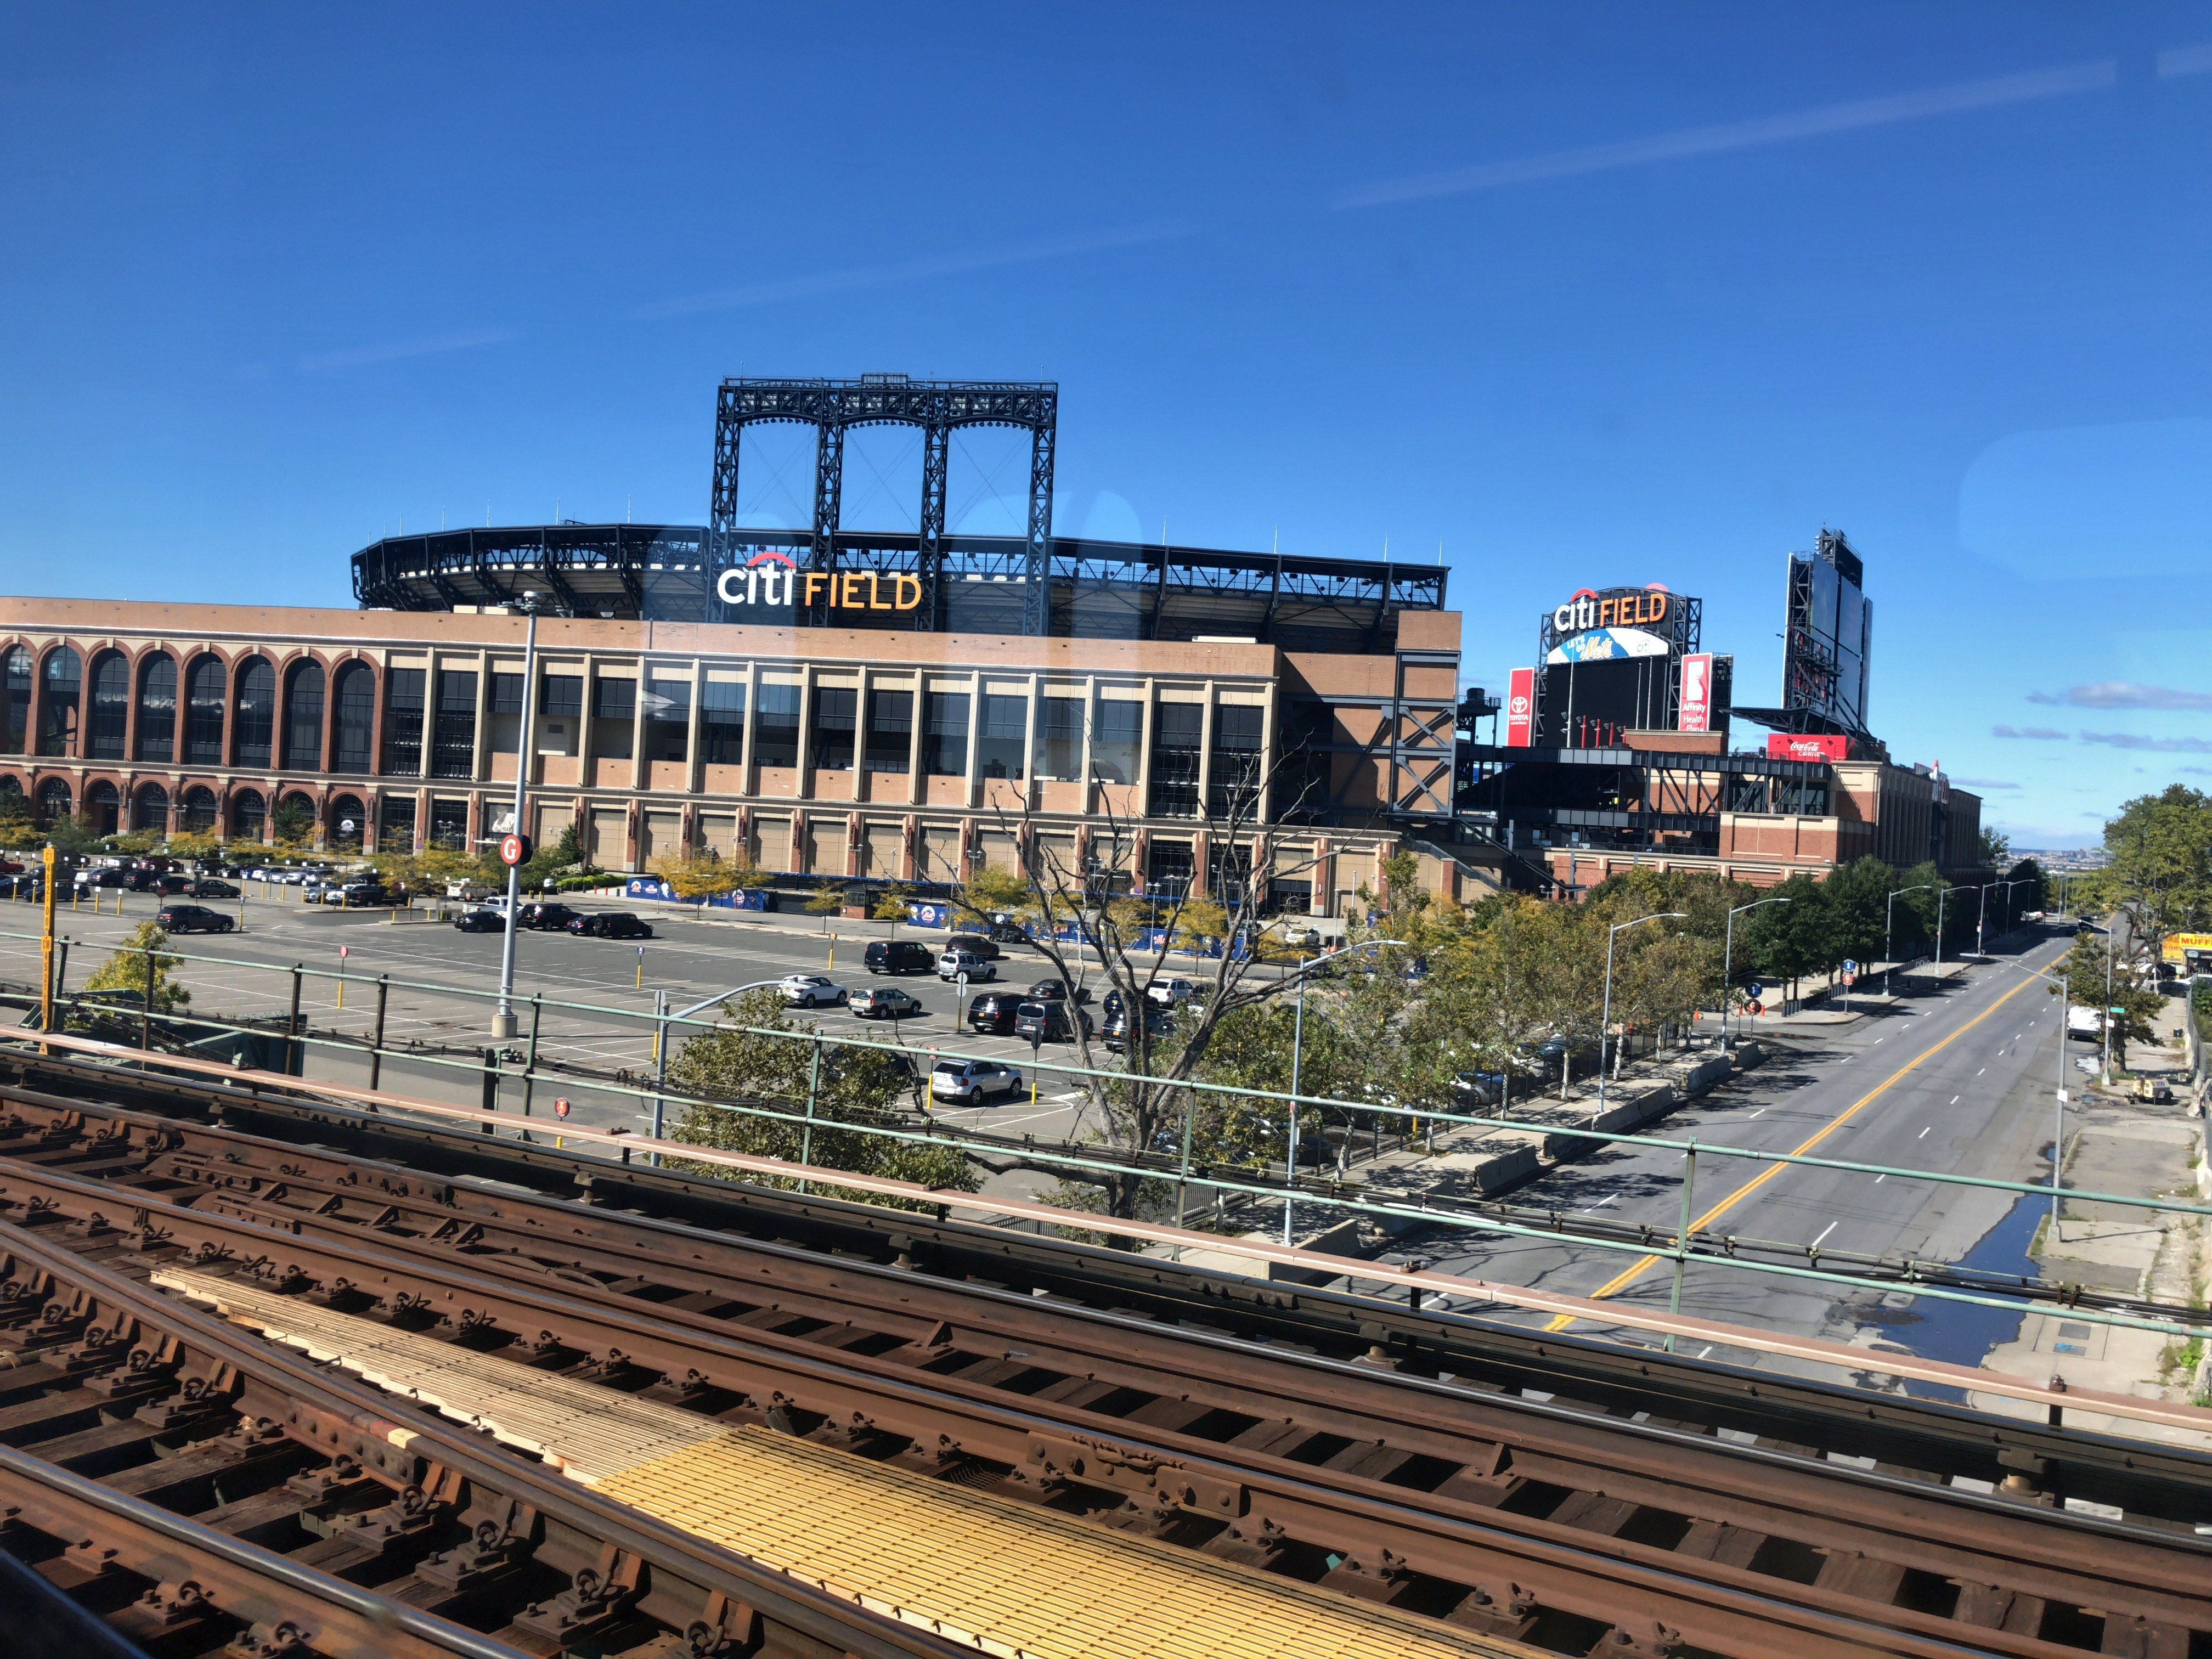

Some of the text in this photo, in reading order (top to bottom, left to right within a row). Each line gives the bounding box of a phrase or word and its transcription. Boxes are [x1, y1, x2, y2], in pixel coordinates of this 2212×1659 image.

[717, 560, 922, 610] citi FIELD
[1554, 593, 1667, 631] citi FIELD
[1579, 636, 1613, 660] Mets
[1637, 642, 1650, 653] cit
[1682, 702, 1706, 713] Affinity
[1683, 714, 1703, 723] Health
[504, 839, 516, 860] G
[42, 939, 50, 949] CM
